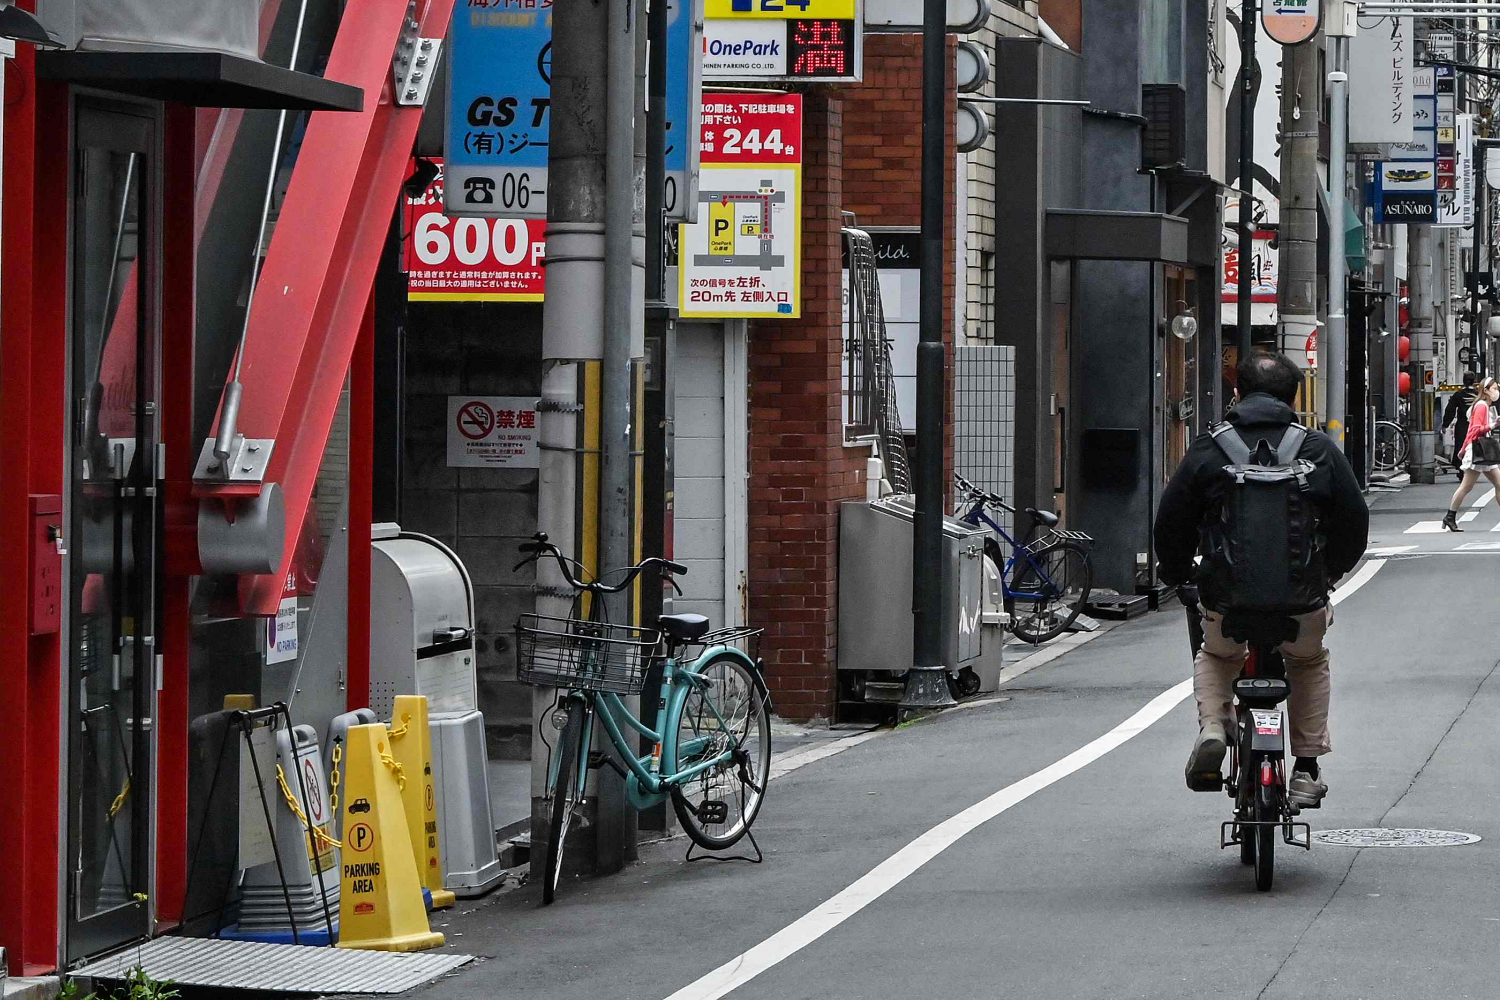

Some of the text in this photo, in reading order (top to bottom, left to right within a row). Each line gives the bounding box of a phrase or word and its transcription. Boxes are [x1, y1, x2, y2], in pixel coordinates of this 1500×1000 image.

[709, 39, 780, 56] OnePark
[1384, 204, 1432, 215] ASUNARO
[714, 218, 729, 237] P
[690, 290, 788, 303] 20m先 左側入口
[496, 409, 536, 429] 禁煙
[357, 826, 366, 848] P
[344, 862, 380, 879] PARKING
[352, 879, 374, 894] AREA
